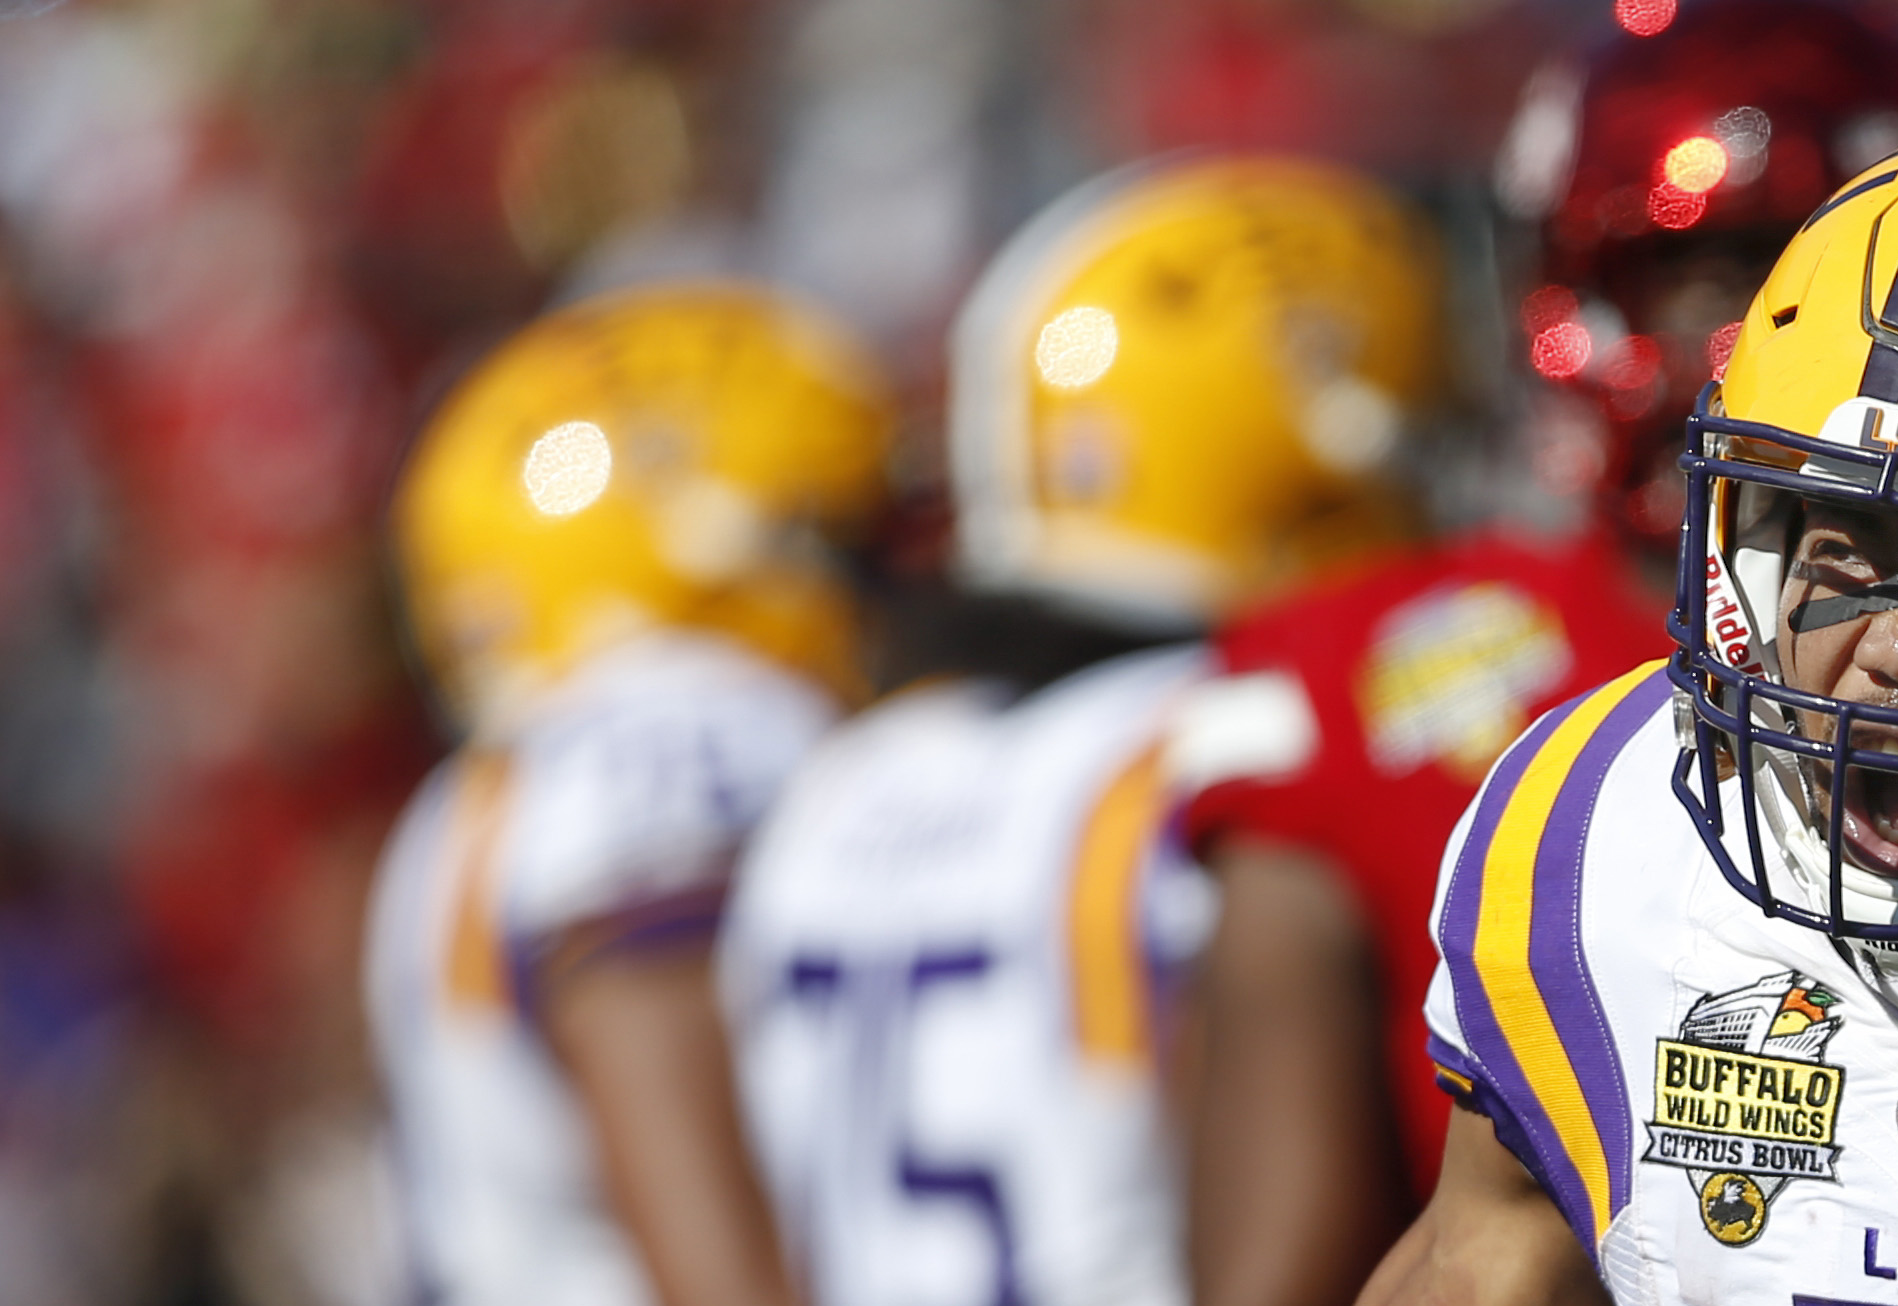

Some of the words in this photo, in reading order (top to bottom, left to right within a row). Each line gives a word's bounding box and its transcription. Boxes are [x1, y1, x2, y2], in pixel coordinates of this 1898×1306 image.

[1665, 1049, 1831, 1107] BUFFALO
[1665, 1093, 1730, 1129] WILD
[1739, 1101, 1825, 1139] WINGS
[1660, 1132, 1744, 1166] CITRUS
[1752, 1143, 1824, 1173] BOWL
